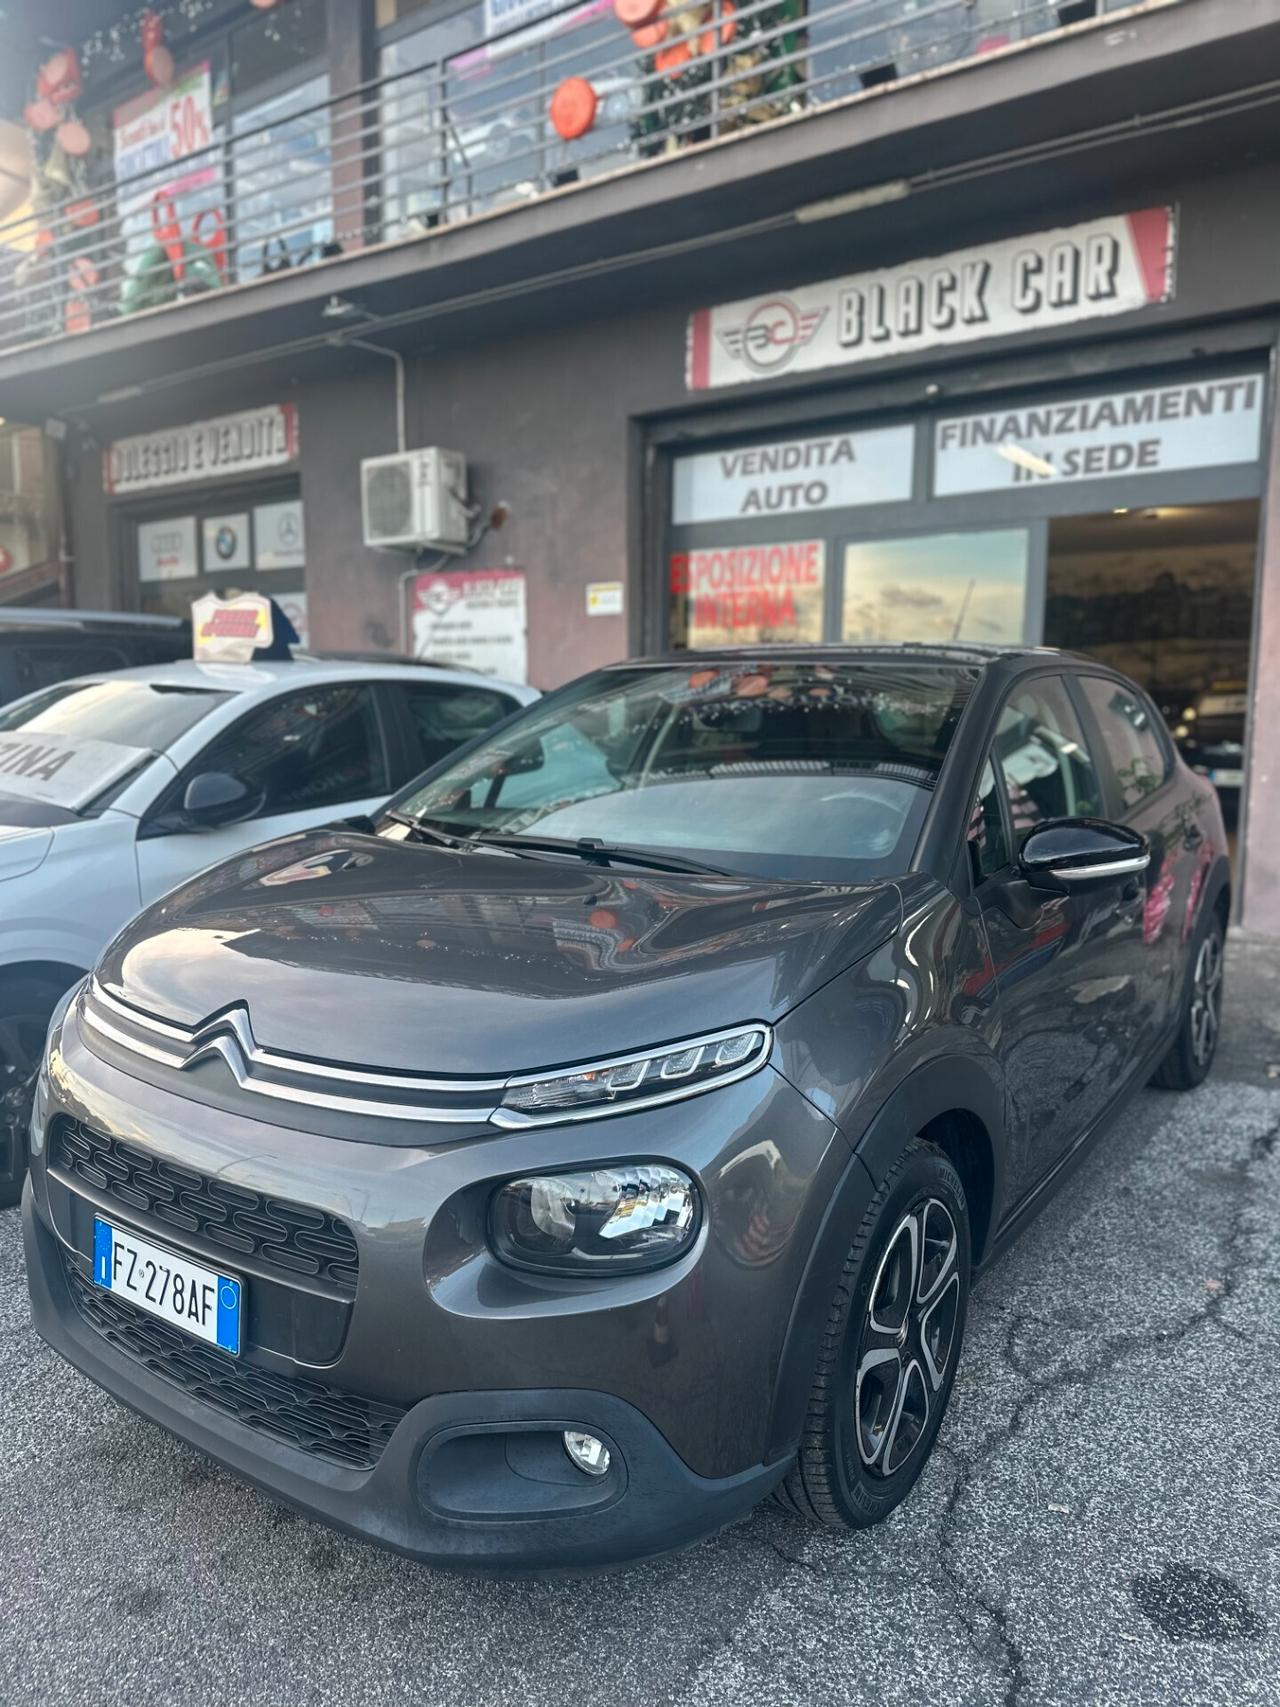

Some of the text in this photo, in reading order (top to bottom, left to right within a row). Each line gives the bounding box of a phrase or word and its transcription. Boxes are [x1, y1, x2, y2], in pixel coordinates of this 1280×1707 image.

[839, 260, 989, 346] BLACK
[1012, 233, 1118, 310] CAR
[940, 380, 1256, 451] FINANZIAMENTI
[720, 437, 856, 479] VENDITA
[1062, 438, 1162, 475] SEDE
[740, 479, 828, 514] AUTO
[671, 541, 820, 595] ESPOSIZIONE
[695, 588, 797, 629] INTERNA
